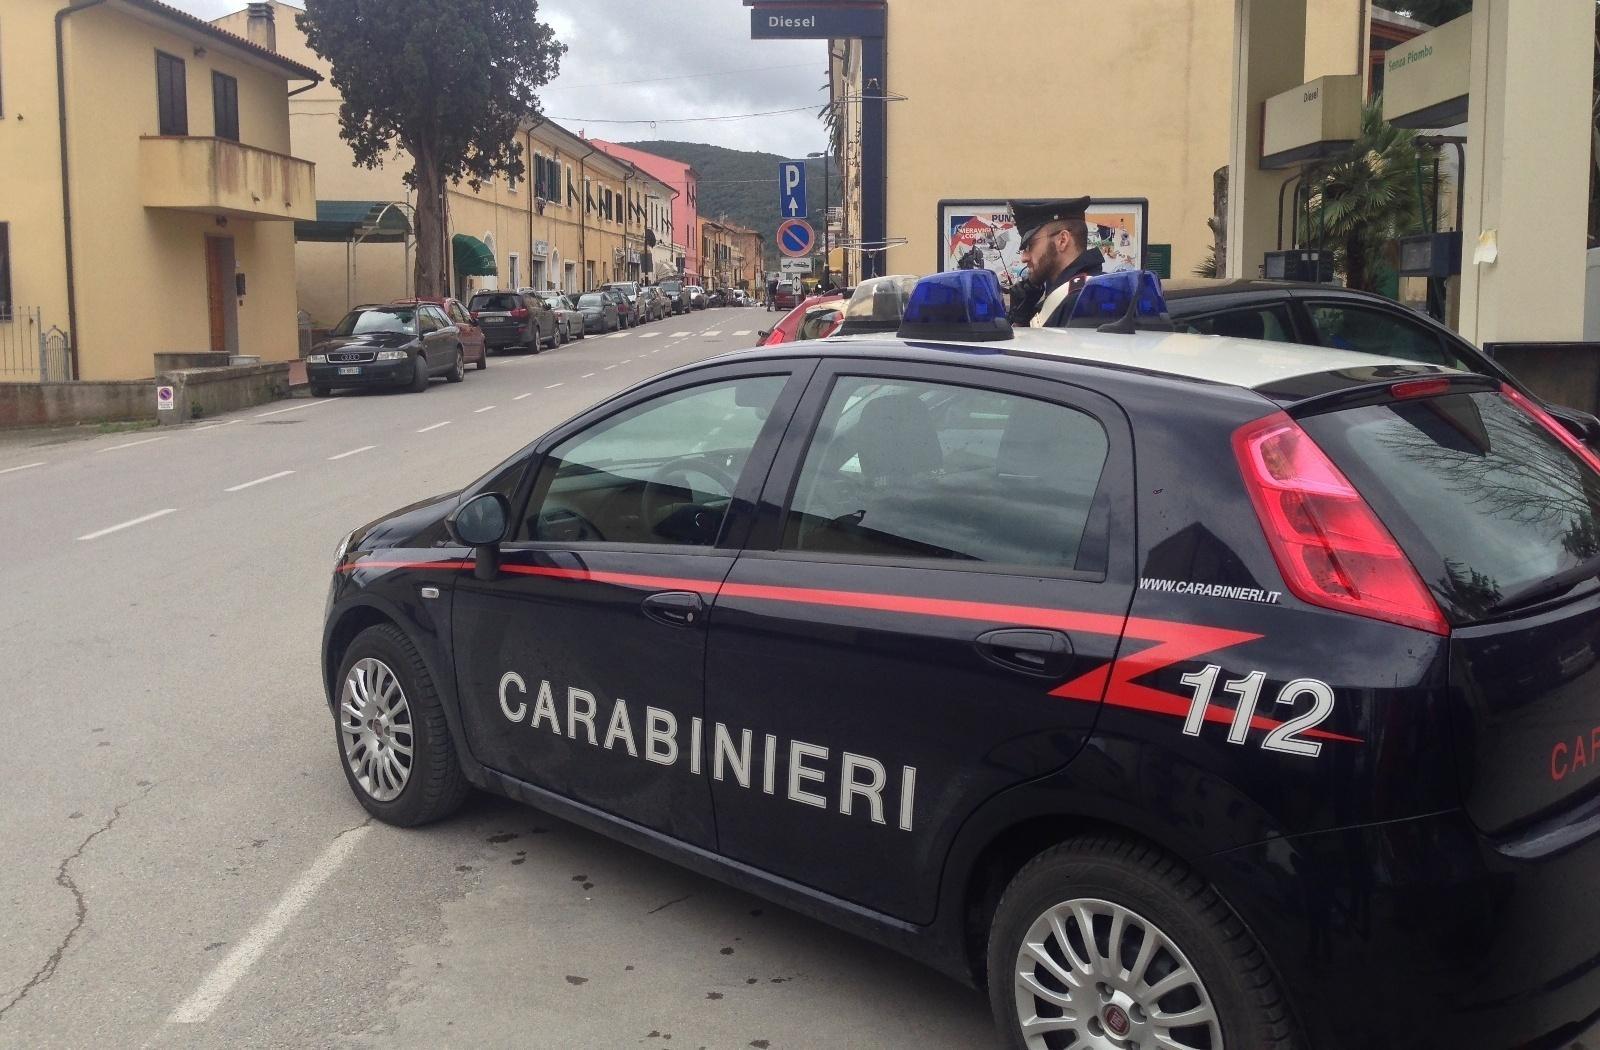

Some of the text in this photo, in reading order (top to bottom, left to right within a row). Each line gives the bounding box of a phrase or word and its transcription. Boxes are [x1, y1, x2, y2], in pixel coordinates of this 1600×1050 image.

[768, 15, 816, 28] Diesel
[1388, 44, 1434, 72] Senza Piombo
[1303, 87, 1319, 103] Diesel
[785, 164, 800, 196] P
[991, 214, 1012, 223] PUN
[1139, 577, 1282, 604] WWW.CARABINIERI.IT
[1179, 664, 1335, 758] 112
[499, 671, 917, 832] CARABINIERI
